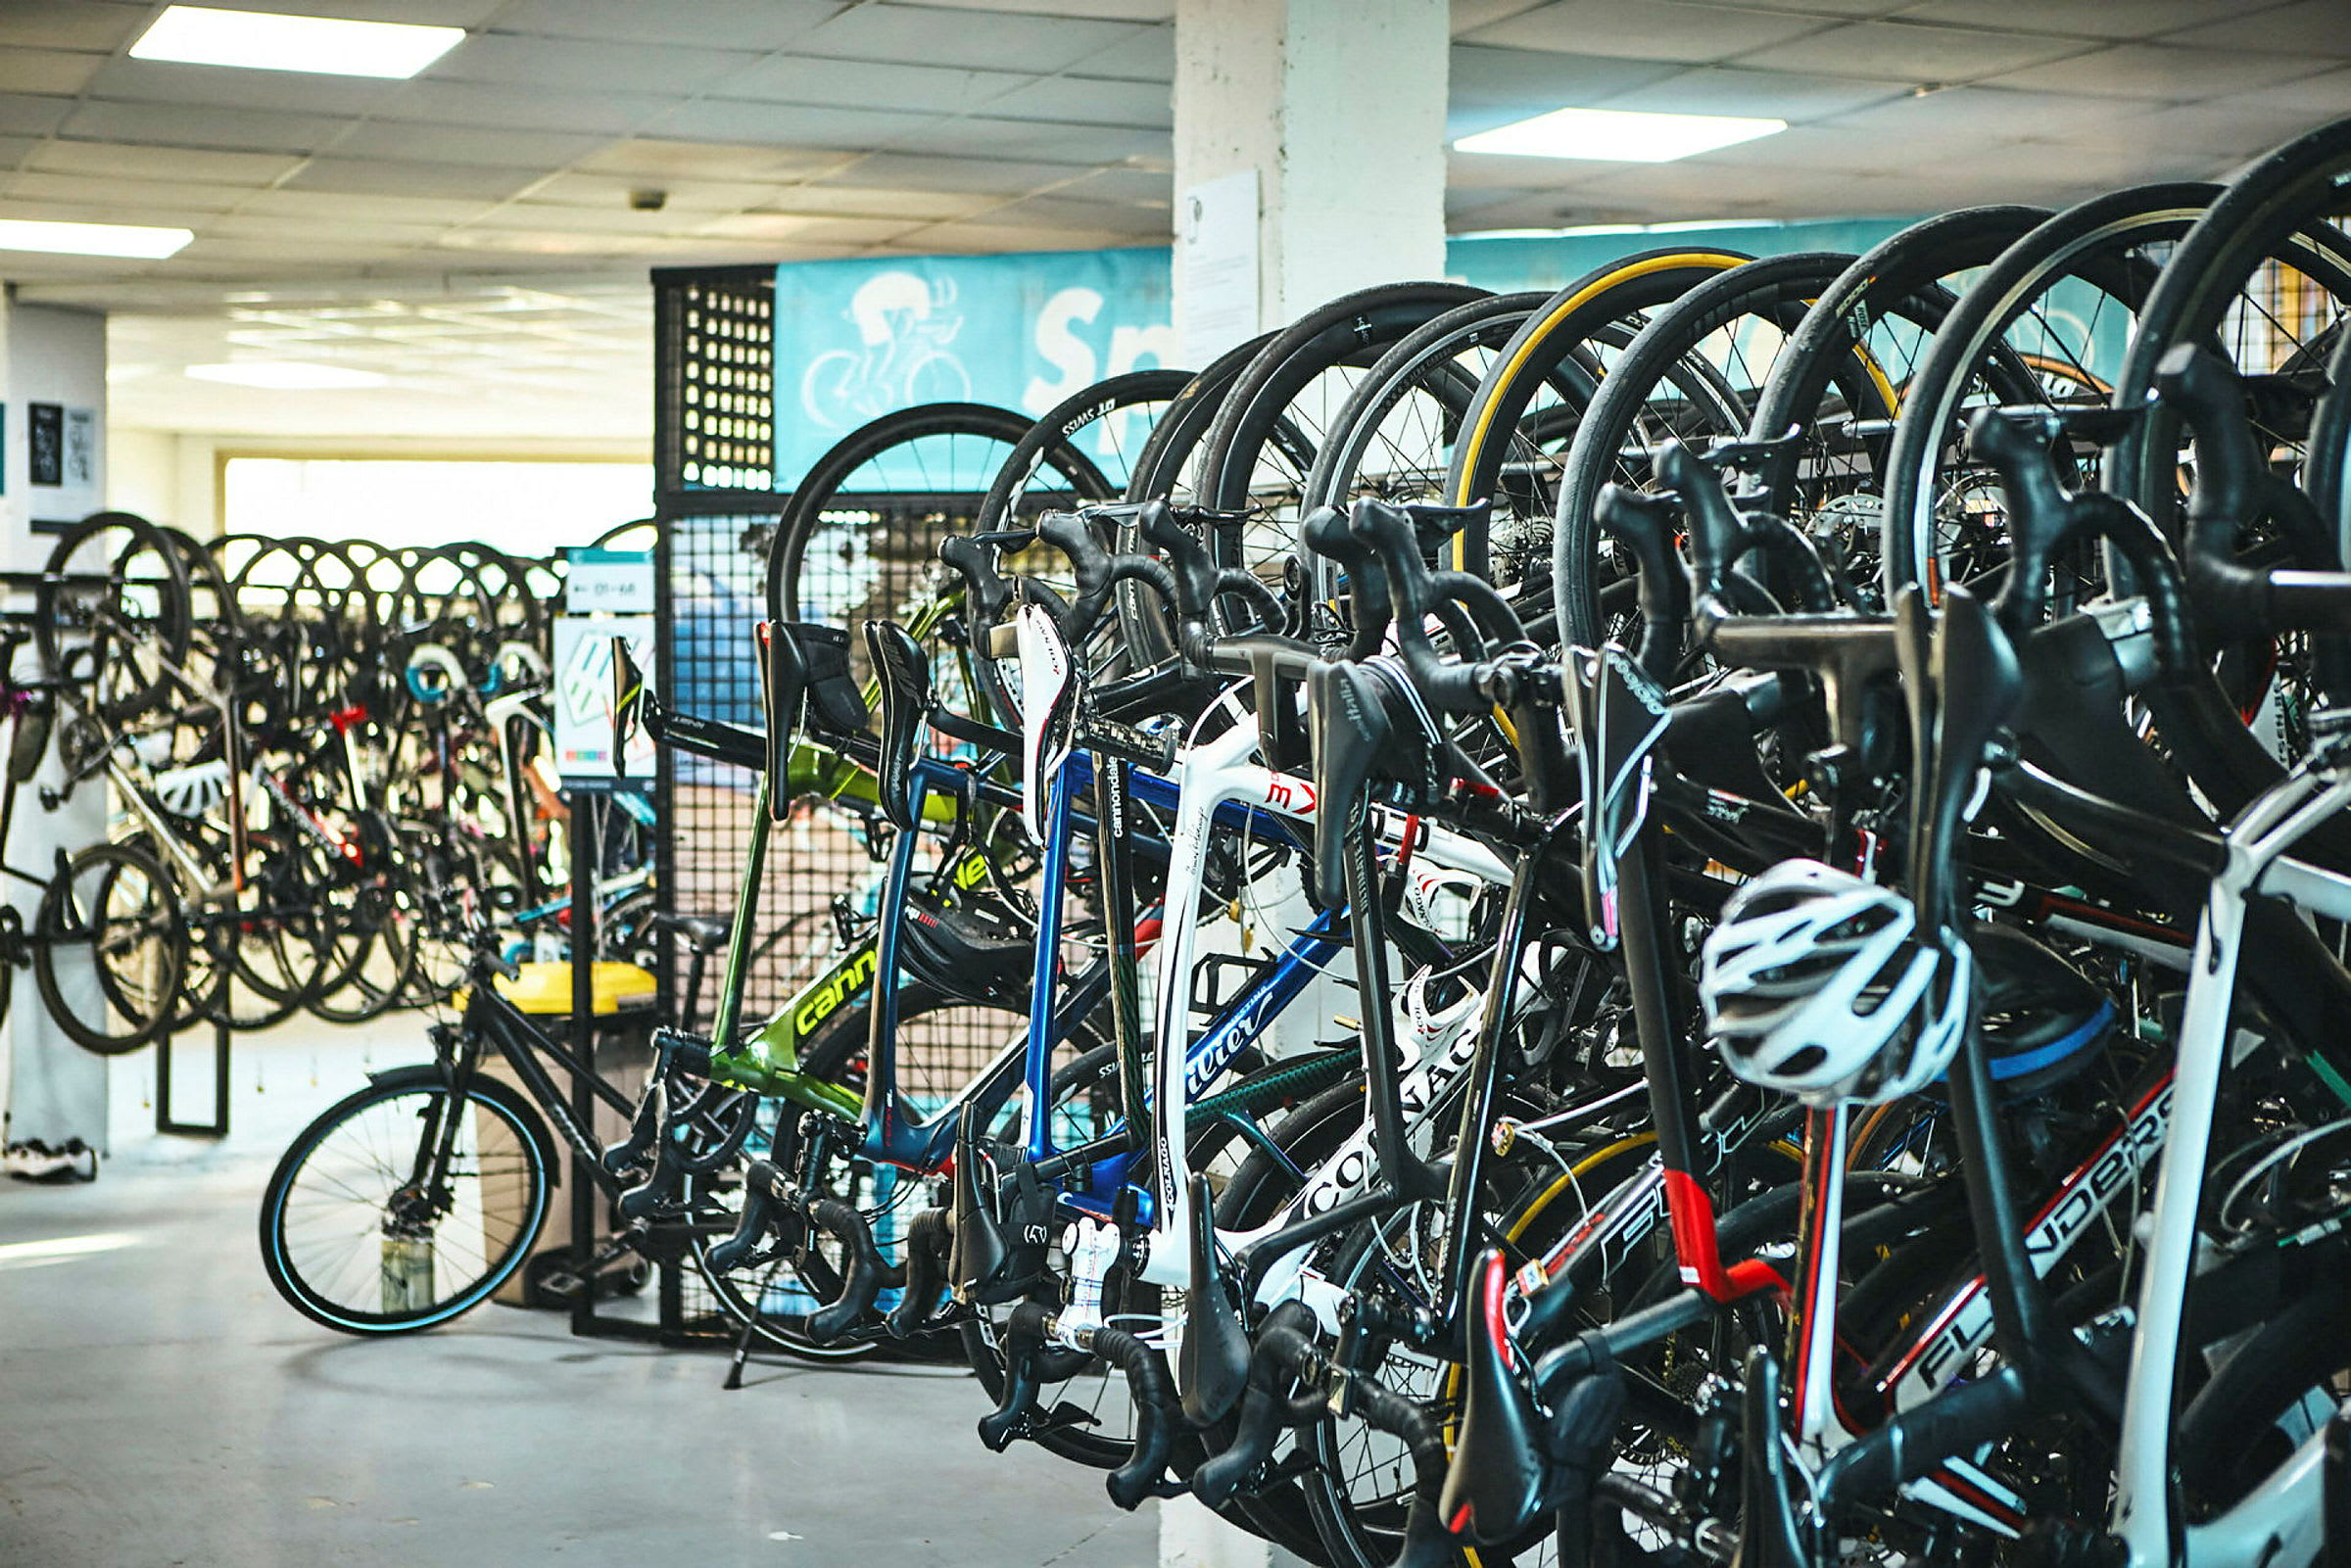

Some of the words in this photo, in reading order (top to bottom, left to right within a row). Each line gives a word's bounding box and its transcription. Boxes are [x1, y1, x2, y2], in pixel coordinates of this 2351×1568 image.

[1062, 408, 1094, 437] SWISS
[1097, 398, 1116, 415] DT
[1108, 755, 1124, 838] cannondale
[1187, 992, 1273, 1095] ilier
[1160, 1136, 1176, 1206] COLNAGO
